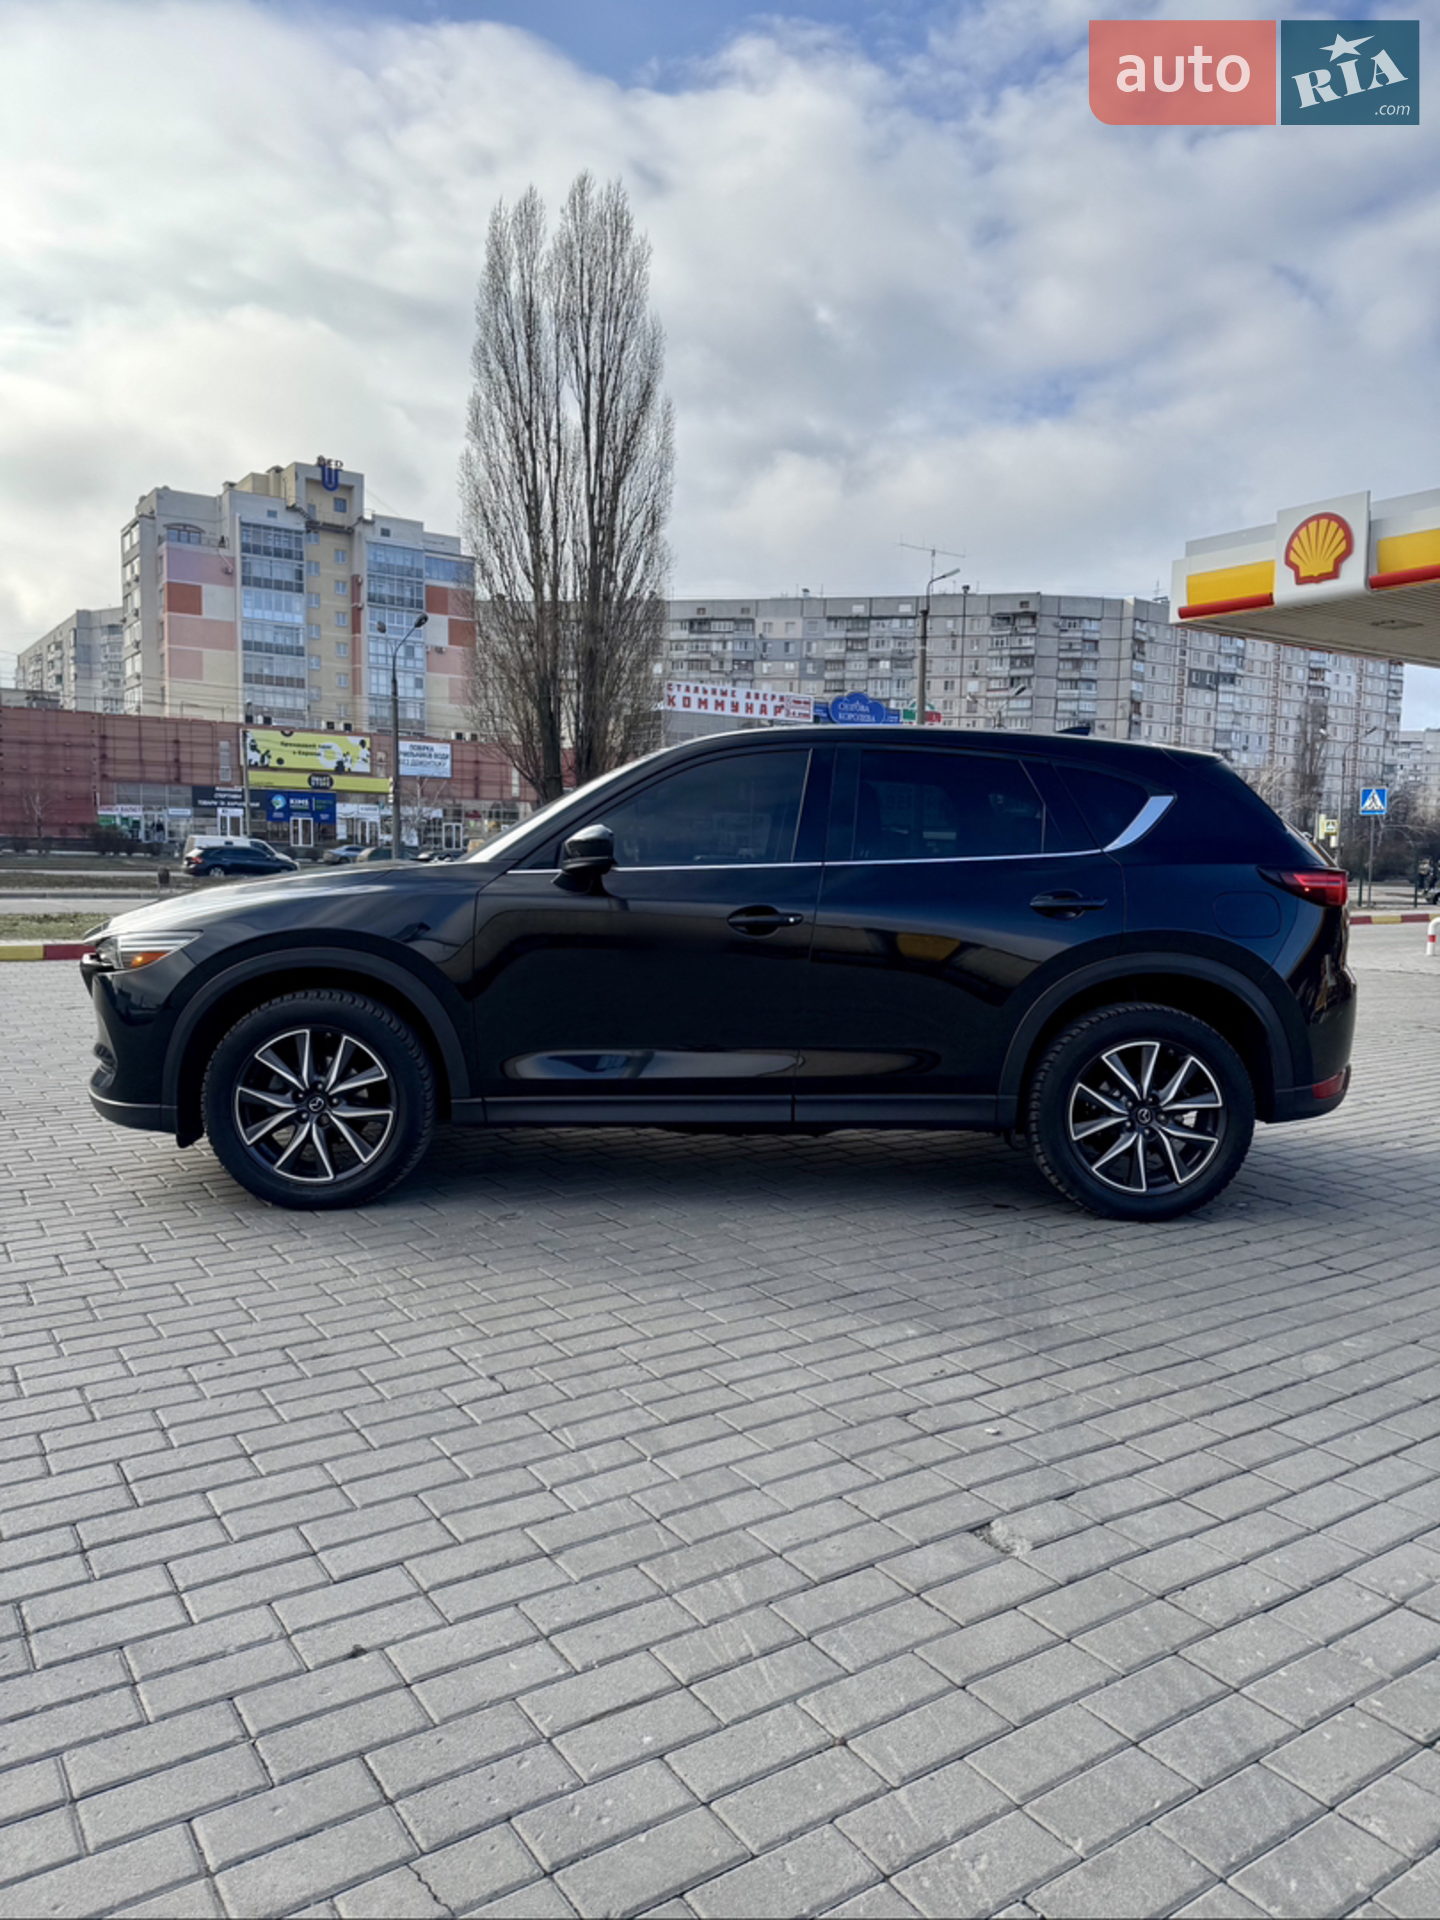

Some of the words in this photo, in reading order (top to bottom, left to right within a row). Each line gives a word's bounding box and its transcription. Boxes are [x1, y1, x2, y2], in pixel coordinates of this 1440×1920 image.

[667, 682, 737, 698] СТАЛЬНЫЕ
[745, 691, 785, 703] ДВЕРИ
[667, 694, 785, 717] КОММУНАР
